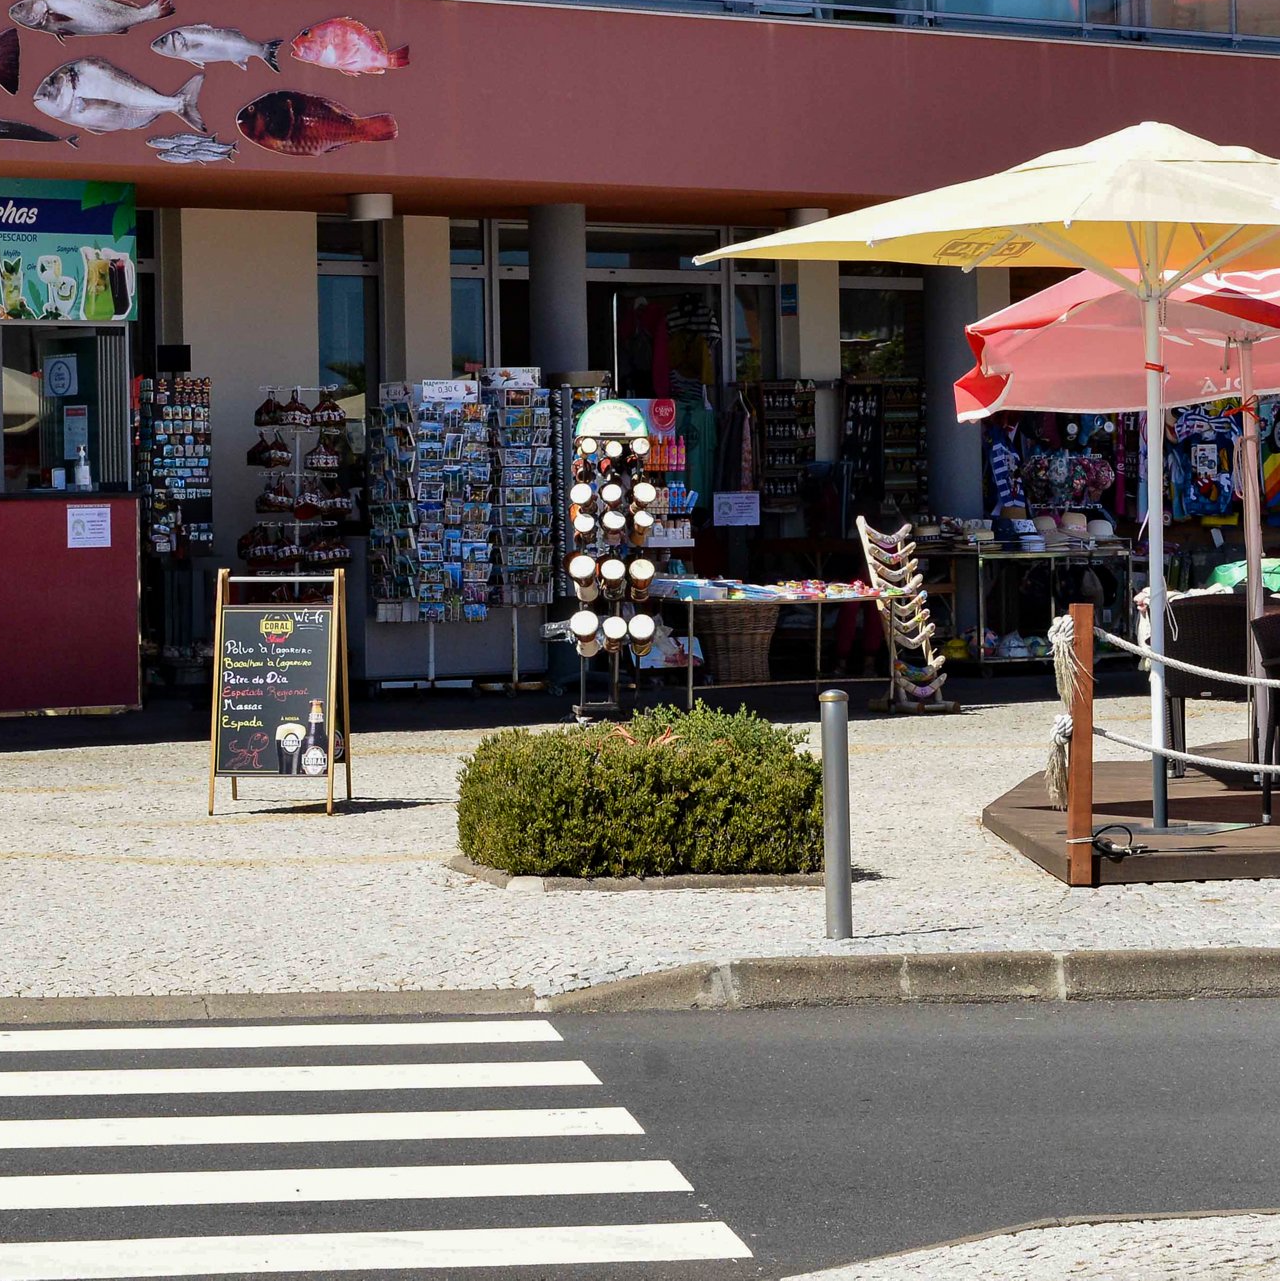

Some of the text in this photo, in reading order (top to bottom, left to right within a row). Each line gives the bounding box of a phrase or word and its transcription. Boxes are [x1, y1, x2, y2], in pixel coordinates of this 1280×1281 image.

[265, 622, 289, 630] CORAL
[225, 639, 254, 655] Polvo
[266, 672, 288, 684] Dia
[222, 716, 264, 730] Espada
